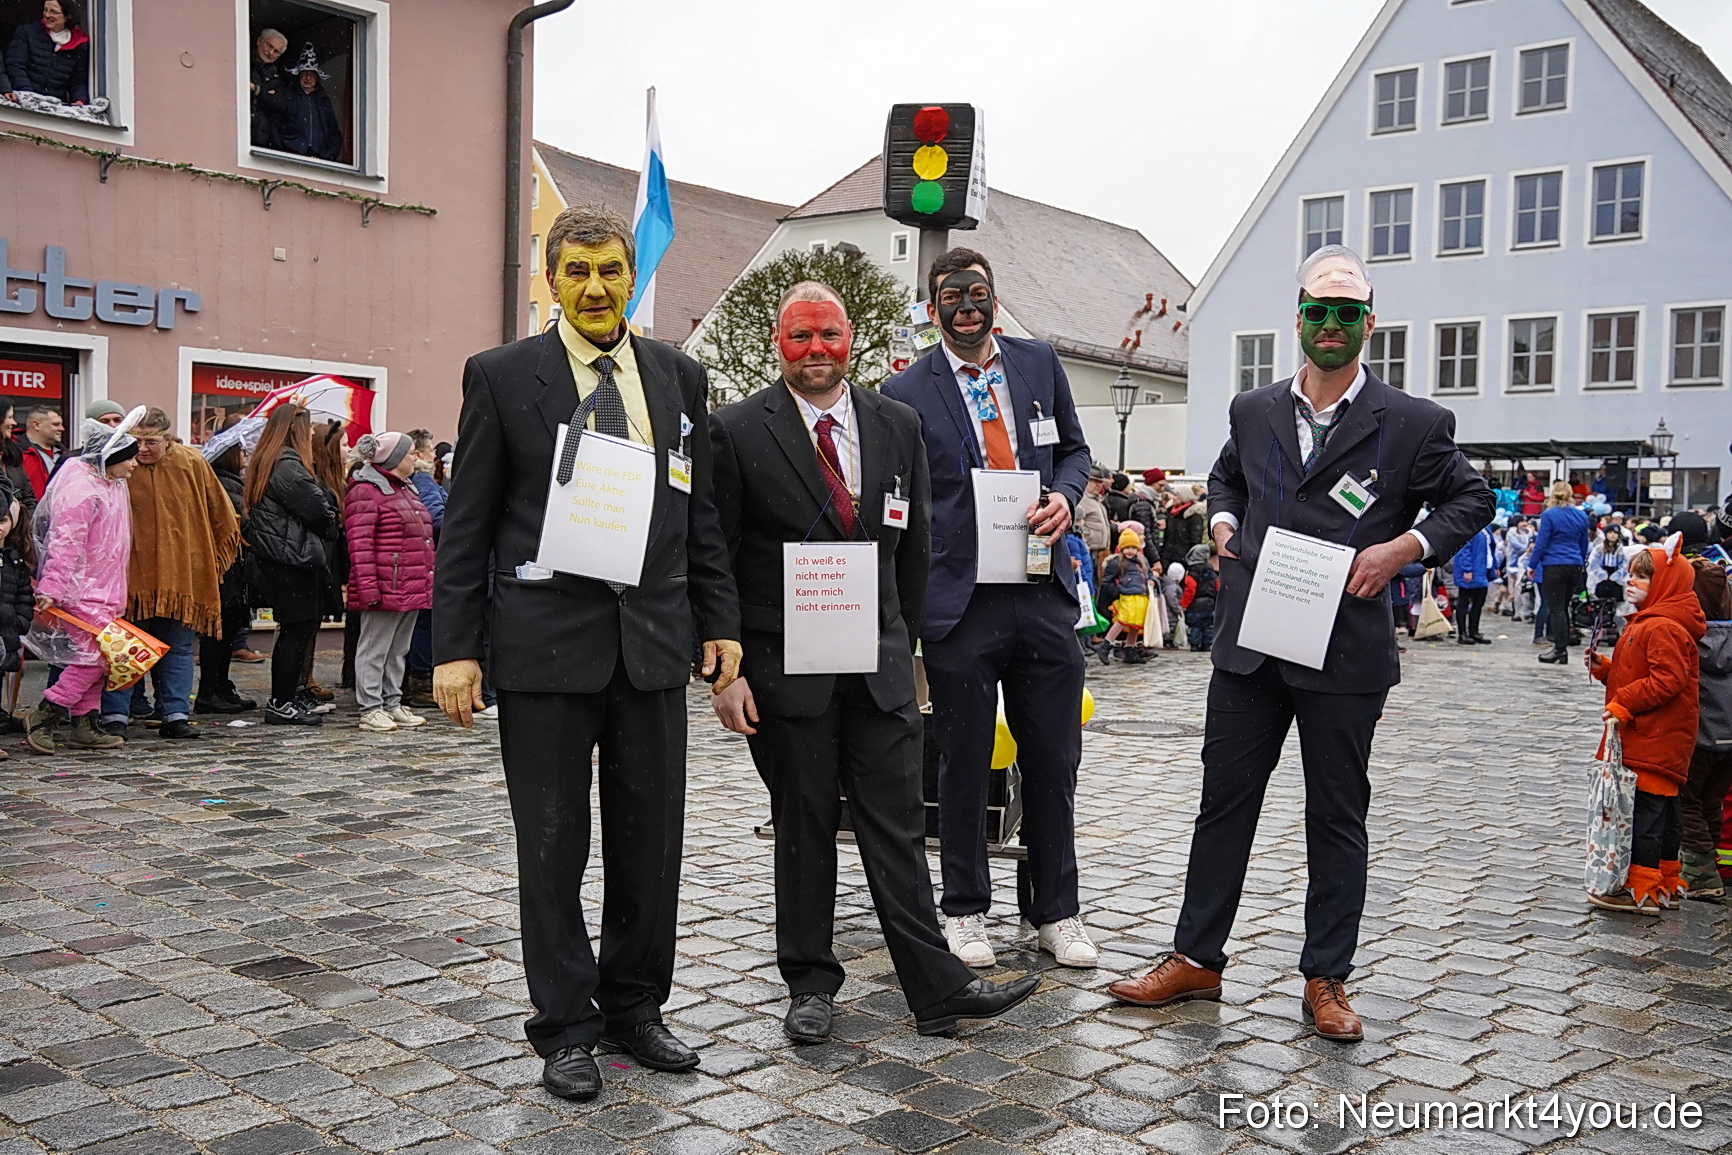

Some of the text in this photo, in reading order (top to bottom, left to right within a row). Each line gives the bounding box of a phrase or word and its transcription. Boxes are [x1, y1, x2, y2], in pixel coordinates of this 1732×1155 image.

[919, 330, 929, 339] 100
[216, 375, 274, 392] idee+spiel
[576, 460, 642, 482] Wäre die FDP
[576, 478, 625, 496] Eine Aktie
[1008, 494, 1018, 502] für
[572, 495, 625, 514] Sollte man
[570, 512, 627, 532] Nun kaufen
[992, 522, 1028, 531] Neuwahlen
[1275, 541, 1334, 562] Vaterlandsliebe fand
[795, 557, 809, 566] Ich
[811, 556, 834, 566] weiß
[1281, 553, 1295, 561] stets
[796, 571, 846, 580] nicht mehr
[1266, 568, 1320, 588] Deutschland nichts
[1300, 568, 1318, 578] wußte
[796, 587, 844, 596] Kann mich
[1268, 588, 1278, 596] bis
[1278, 590, 1295, 600] heute
[1296, 596, 1311, 604] nicht
[1310, 590, 1325, 598] weiß
[796, 602, 861, 612] nicht erinnern
